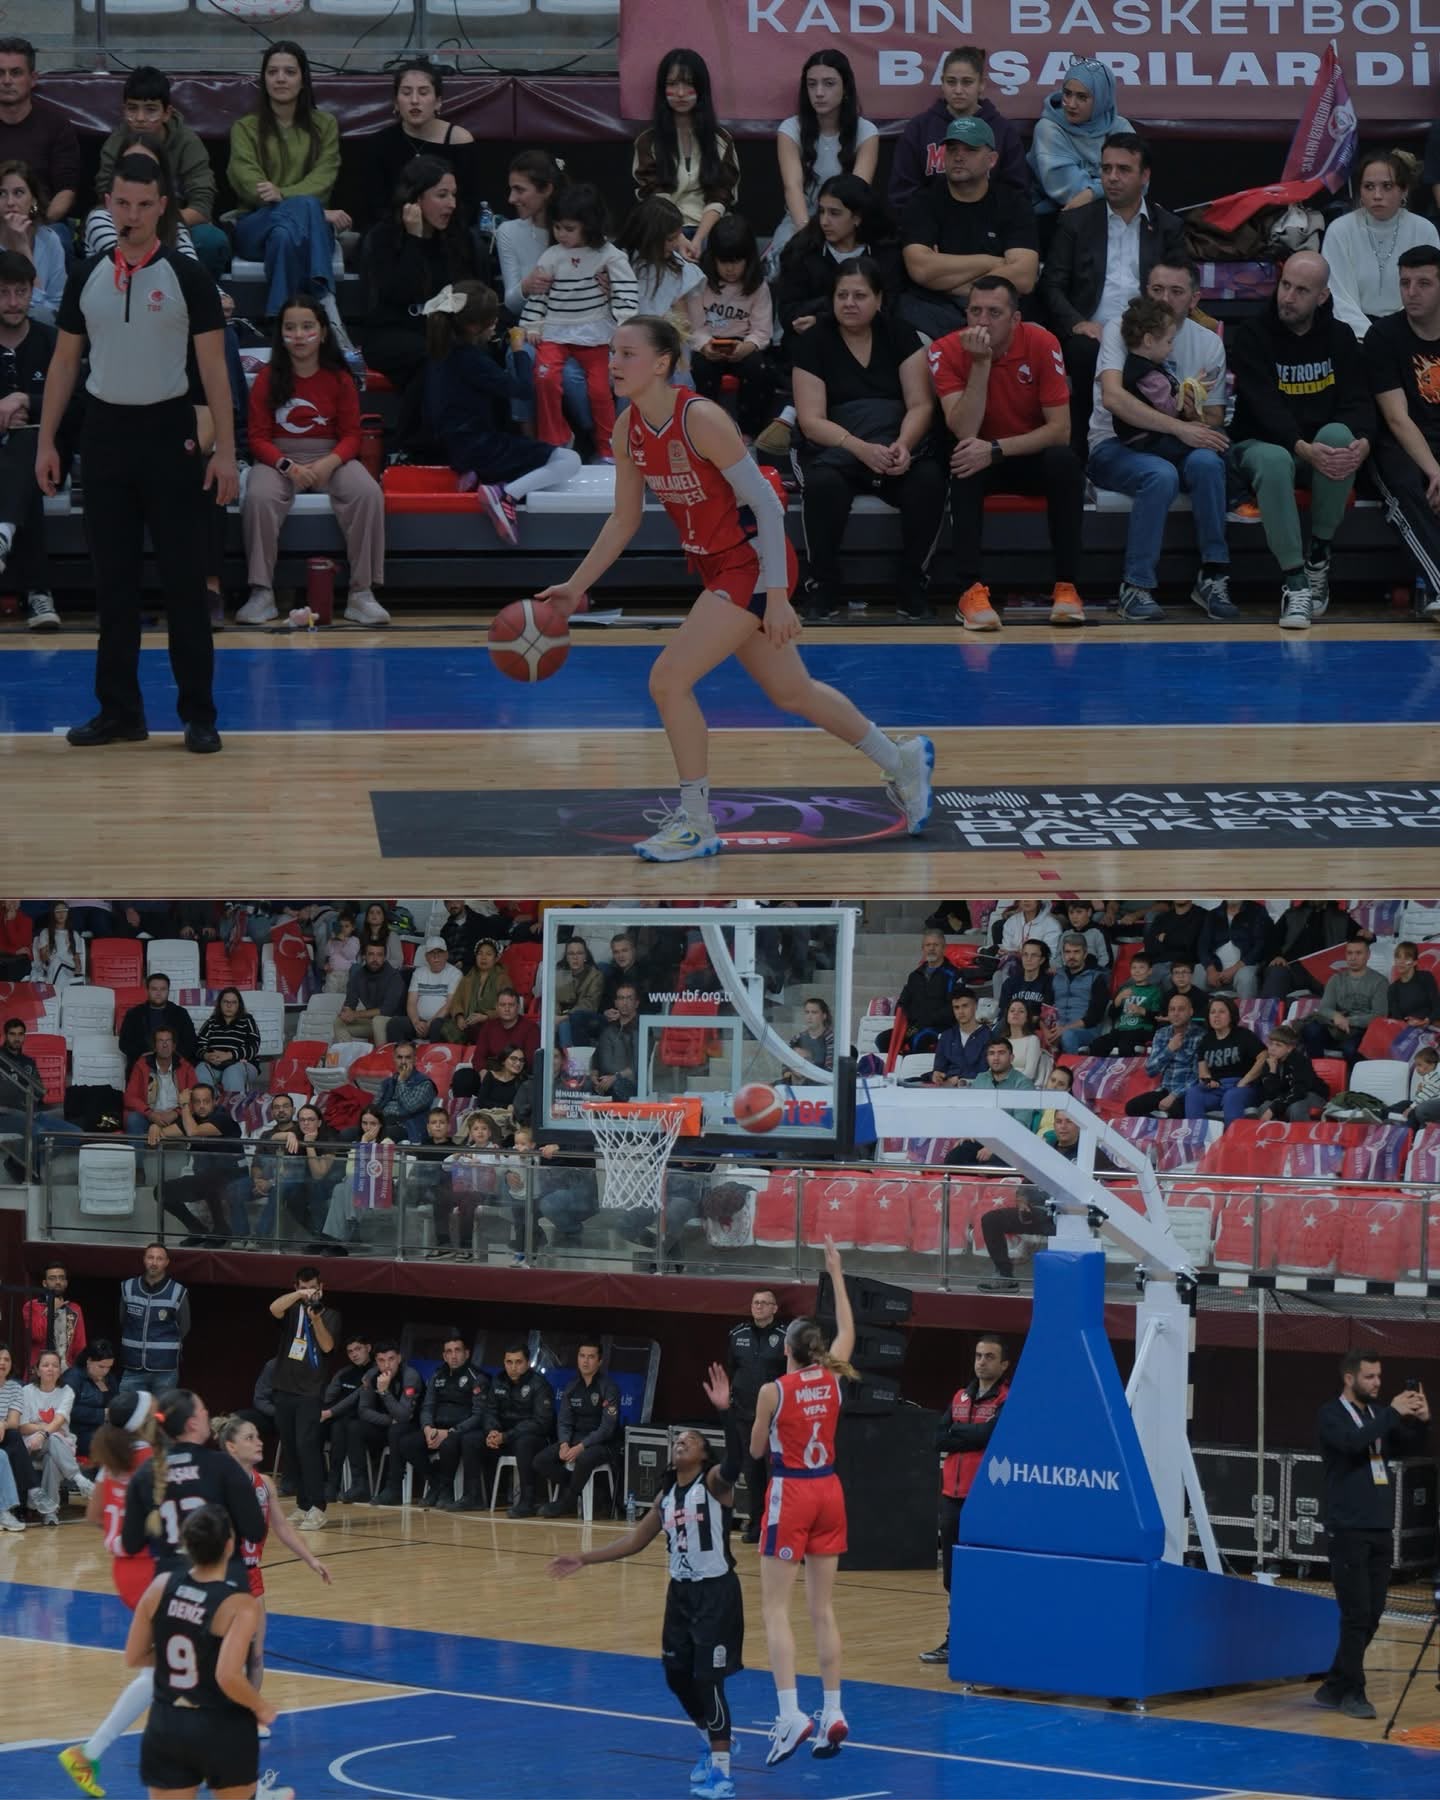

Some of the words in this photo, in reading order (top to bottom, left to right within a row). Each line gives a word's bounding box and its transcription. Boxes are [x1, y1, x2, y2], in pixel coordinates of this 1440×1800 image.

[748, 0, 973, 33] KADIN
[1010, 0, 1440, 35] BASKETBOL
[1355, 42, 1440, 86] Dİ
[648, 989, 733, 1005] www.tbf.org.tr
[784, 1100, 827, 1124] TBF
[795, 1385, 832, 1404] MİNEZ
[803, 1404, 828, 1416] VEFA
[803, 1421, 829, 1469] 6
[1013, 1463, 1120, 1491] HALKBANK
[167, 1599, 206, 1625] DENİZ
[166, 1633, 199, 1690] 9
